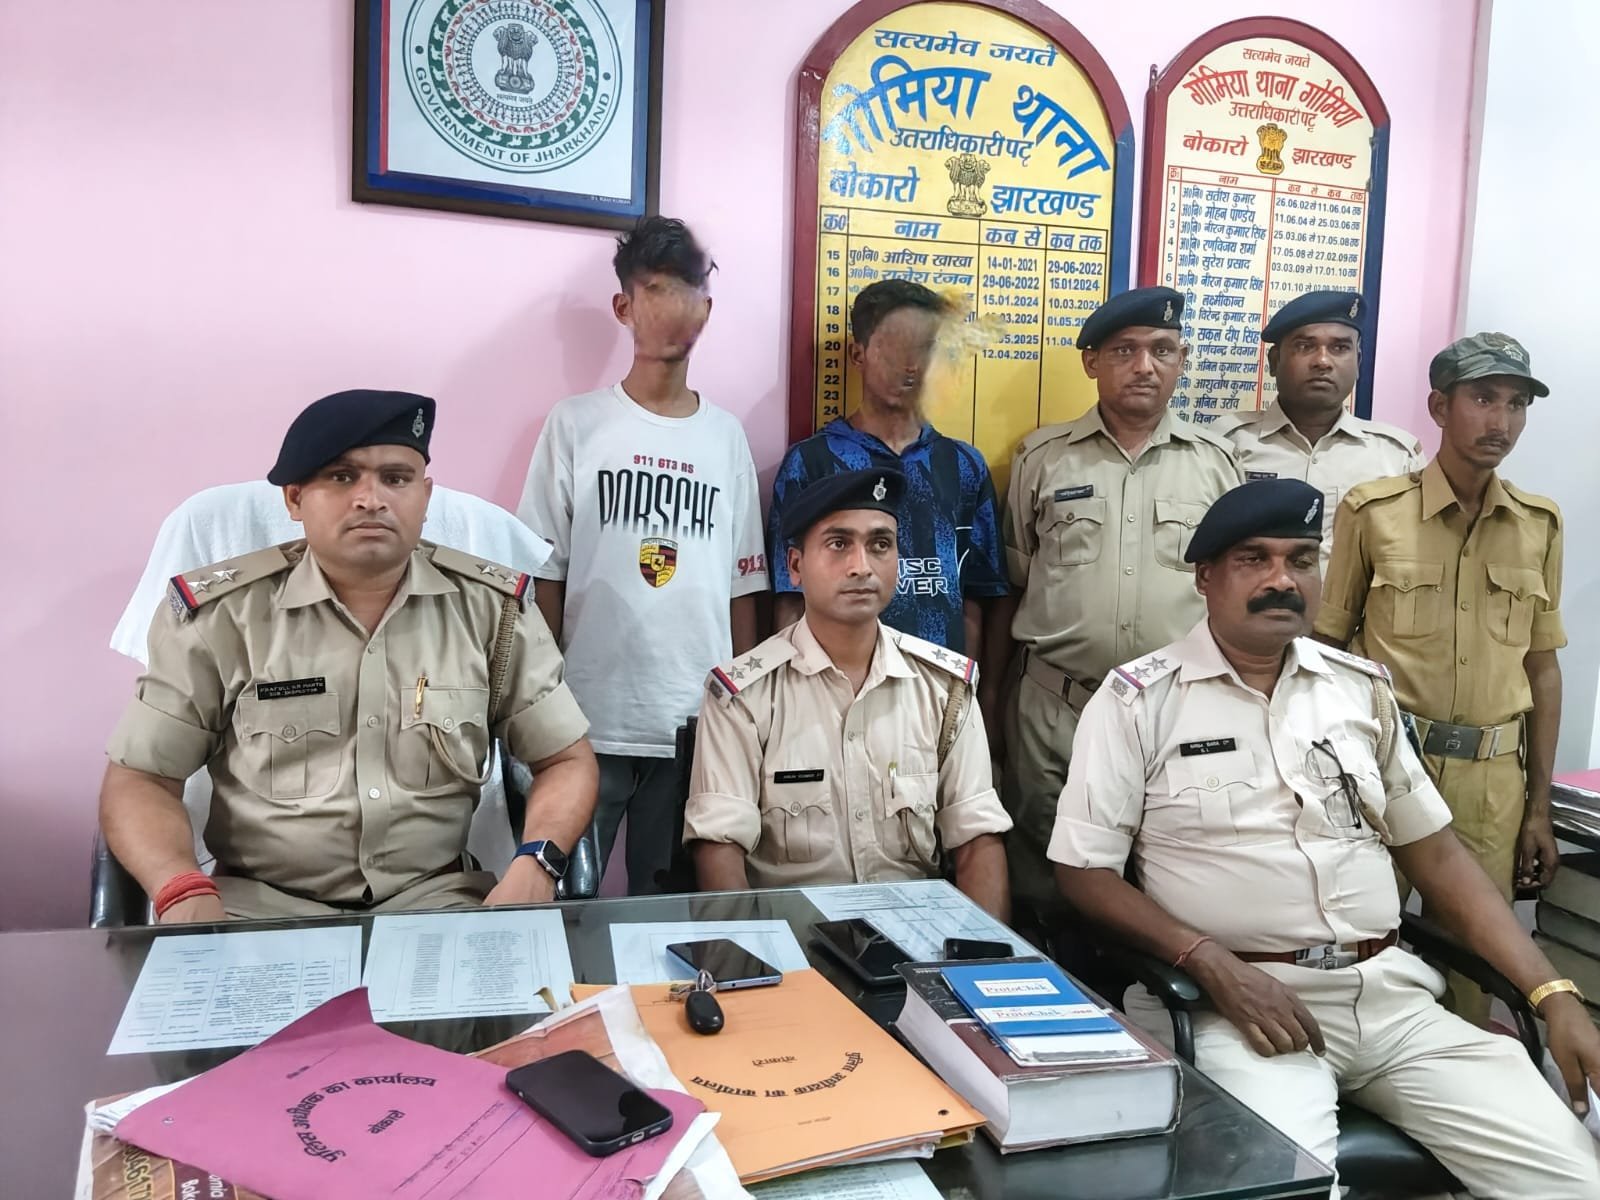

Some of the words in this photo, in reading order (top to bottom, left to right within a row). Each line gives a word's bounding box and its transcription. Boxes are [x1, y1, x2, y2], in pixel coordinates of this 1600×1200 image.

[874, 29, 981, 57] सत्यमेव
[989, 43, 1057, 67] जयते
[1243, 48, 1280, 63] सत्यमेव
[1285, 54, 1310, 68] जयते
[1183, 65, 1248, 105] गोमिया
[1256, 70, 1299, 101] थाना
[1299, 79, 1363, 128] गोमिया
[415, 66, 504, 161] GOVERNMENT
[510, 151, 530, 163] OF
[534, 92, 610, 163] JHARKHAND
[1013, 84, 1110, 180] थाना
[1183, 130, 1249, 155] बोकारो
[1292, 148, 1356, 169] झारखण्ड
[1219, 175, 1239, 185] नाम
[829, 162, 920, 202] बोकारो
[990, 185, 1102, 218] झारखण्ड
[1171, 186, 1176, 195] 1
[1206, 188, 1230, 201] सतीश
[1232, 192, 1256, 207] कुमार
[1288, 183, 1301, 192] कब
[1311, 185, 1318, 195] से
[1327, 189, 1342, 198] कब
[1350, 191, 1365, 200] तक
[1170, 203, 1175, 212] 2
[1205, 202, 1227, 220] मोहन
[1230, 205, 1256, 223] पाण्डेय
[1276, 197, 1309, 210] 26.06.02
[1318, 203, 1350, 214] 11.06.04
[1169, 220, 1175, 229] 3
[1275, 213, 1307, 225] 11.06.04
[1318, 218, 1350, 229] 25.03.06
[895, 220, 941, 240] नाम
[985, 227, 1018, 245] कब
[1024, 225, 1042, 247] से
[1251, 224, 1267, 240] सिंह
[1274, 230, 1306, 241] 25.03.06
[1317, 233, 1349, 246] 17.05.08
[1049, 231, 1073, 250] कब
[1078, 235, 1102, 252] तक
[1168, 237, 1173, 246] 4
[1203, 237, 1238, 253] रणविजय
[1240, 240, 1257, 255] शर्मा
[826, 250, 840, 261] 15
[882, 248, 929, 266] आशिष
[932, 254, 974, 268] खाखा
[1167, 253, 1173, 262] 5
[1202, 253, 1225, 271] सुरेश
[1227, 258, 1251, 270] प्रसाद
[1273, 247, 1305, 258] 17.05.08
[1315, 251, 1348, 262] 27.02.09
[987, 256, 1038, 272] 14-01-2021
[1048, 260, 1103, 275] 29-06-2022
[1272, 262, 1305, 272] 03.03.09
[1315, 267, 1348, 277] 17.01.10
[826, 267, 840, 278] 16
[933, 269, 974, 286] रंजन
[1166, 273, 1172, 282] 6
[982, 275, 1040, 290] 29-06-2022
[1201, 272, 1223, 288] नीरज
[1249, 276, 1264, 291] सिंह
[1271, 281, 1304, 292] 17.01.10
[825, 286, 839, 297] 17
[983, 295, 1039, 308] 15.01.2024
[1048, 298, 1100, 311] 10.03.2024
[826, 305, 840, 317] 18
[1248, 312, 1262, 324] राम
[825, 323, 839, 334] 19
[1197, 327, 1221, 343] सकल
[1224, 325, 1240, 344] दीप
[1242, 325, 1261, 345] सिंह
[824, 341, 841, 352] 20
[982, 349, 1039, 361] 12.04.2026
[825, 358, 839, 369] 21
[1243, 360, 1258, 373] शर्मा
[824, 375, 840, 386] 22
[824, 390, 840, 402] 23
[823, 406, 839, 417] 24
[633, 454, 654, 467] 911
[658, 458, 678, 470] GT3
[681, 462, 694, 474] RS
[738, 553, 766, 576] 911
[898, 557, 941, 578] ISC
[896, 577, 949, 597] VER
[353, 1072, 437, 1088] कार्यालय
[690, 1076, 758, 1098] कार्यालय
[323, 1081, 351, 1096] का
[764, 1089, 789, 1098] का
[287, 1092, 325, 1130] अधीक्षक
[367, 1109, 406, 1136] बोकारो
[297, 1130, 346, 1163] पुलिस
